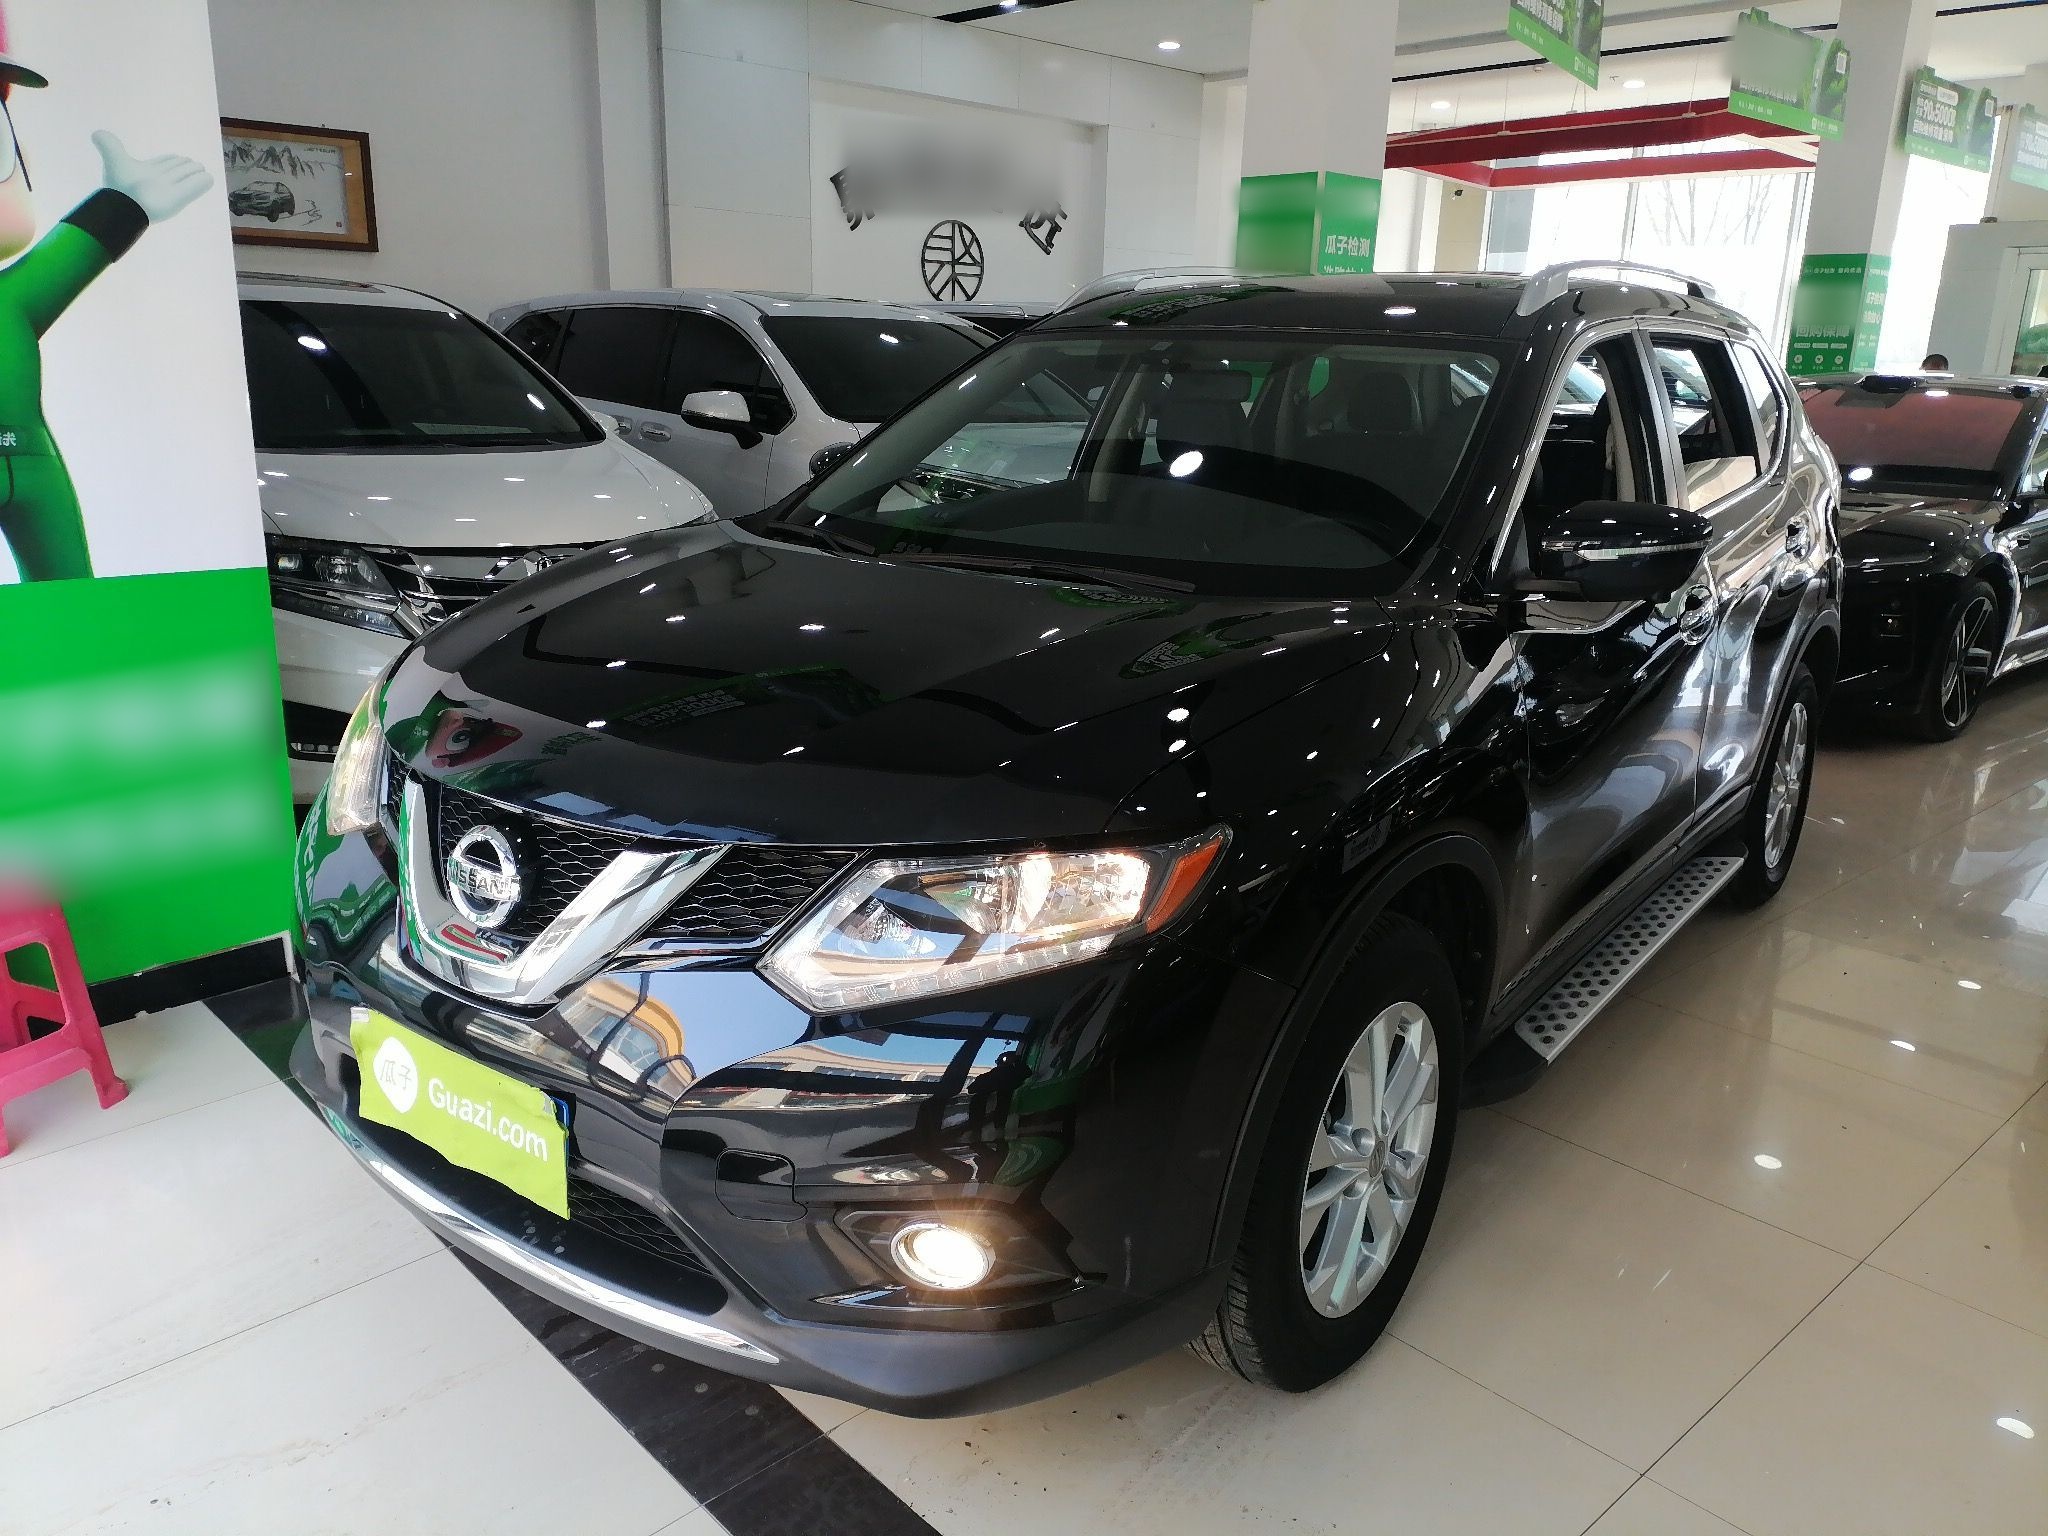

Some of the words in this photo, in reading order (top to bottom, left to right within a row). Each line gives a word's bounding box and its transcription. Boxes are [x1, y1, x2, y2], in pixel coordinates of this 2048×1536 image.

[1325, 234, 1371, 257] 瓜子检测
[379, 1059, 413, 1091] 瓜子
[428, 1077, 548, 1162] Guazi.com
